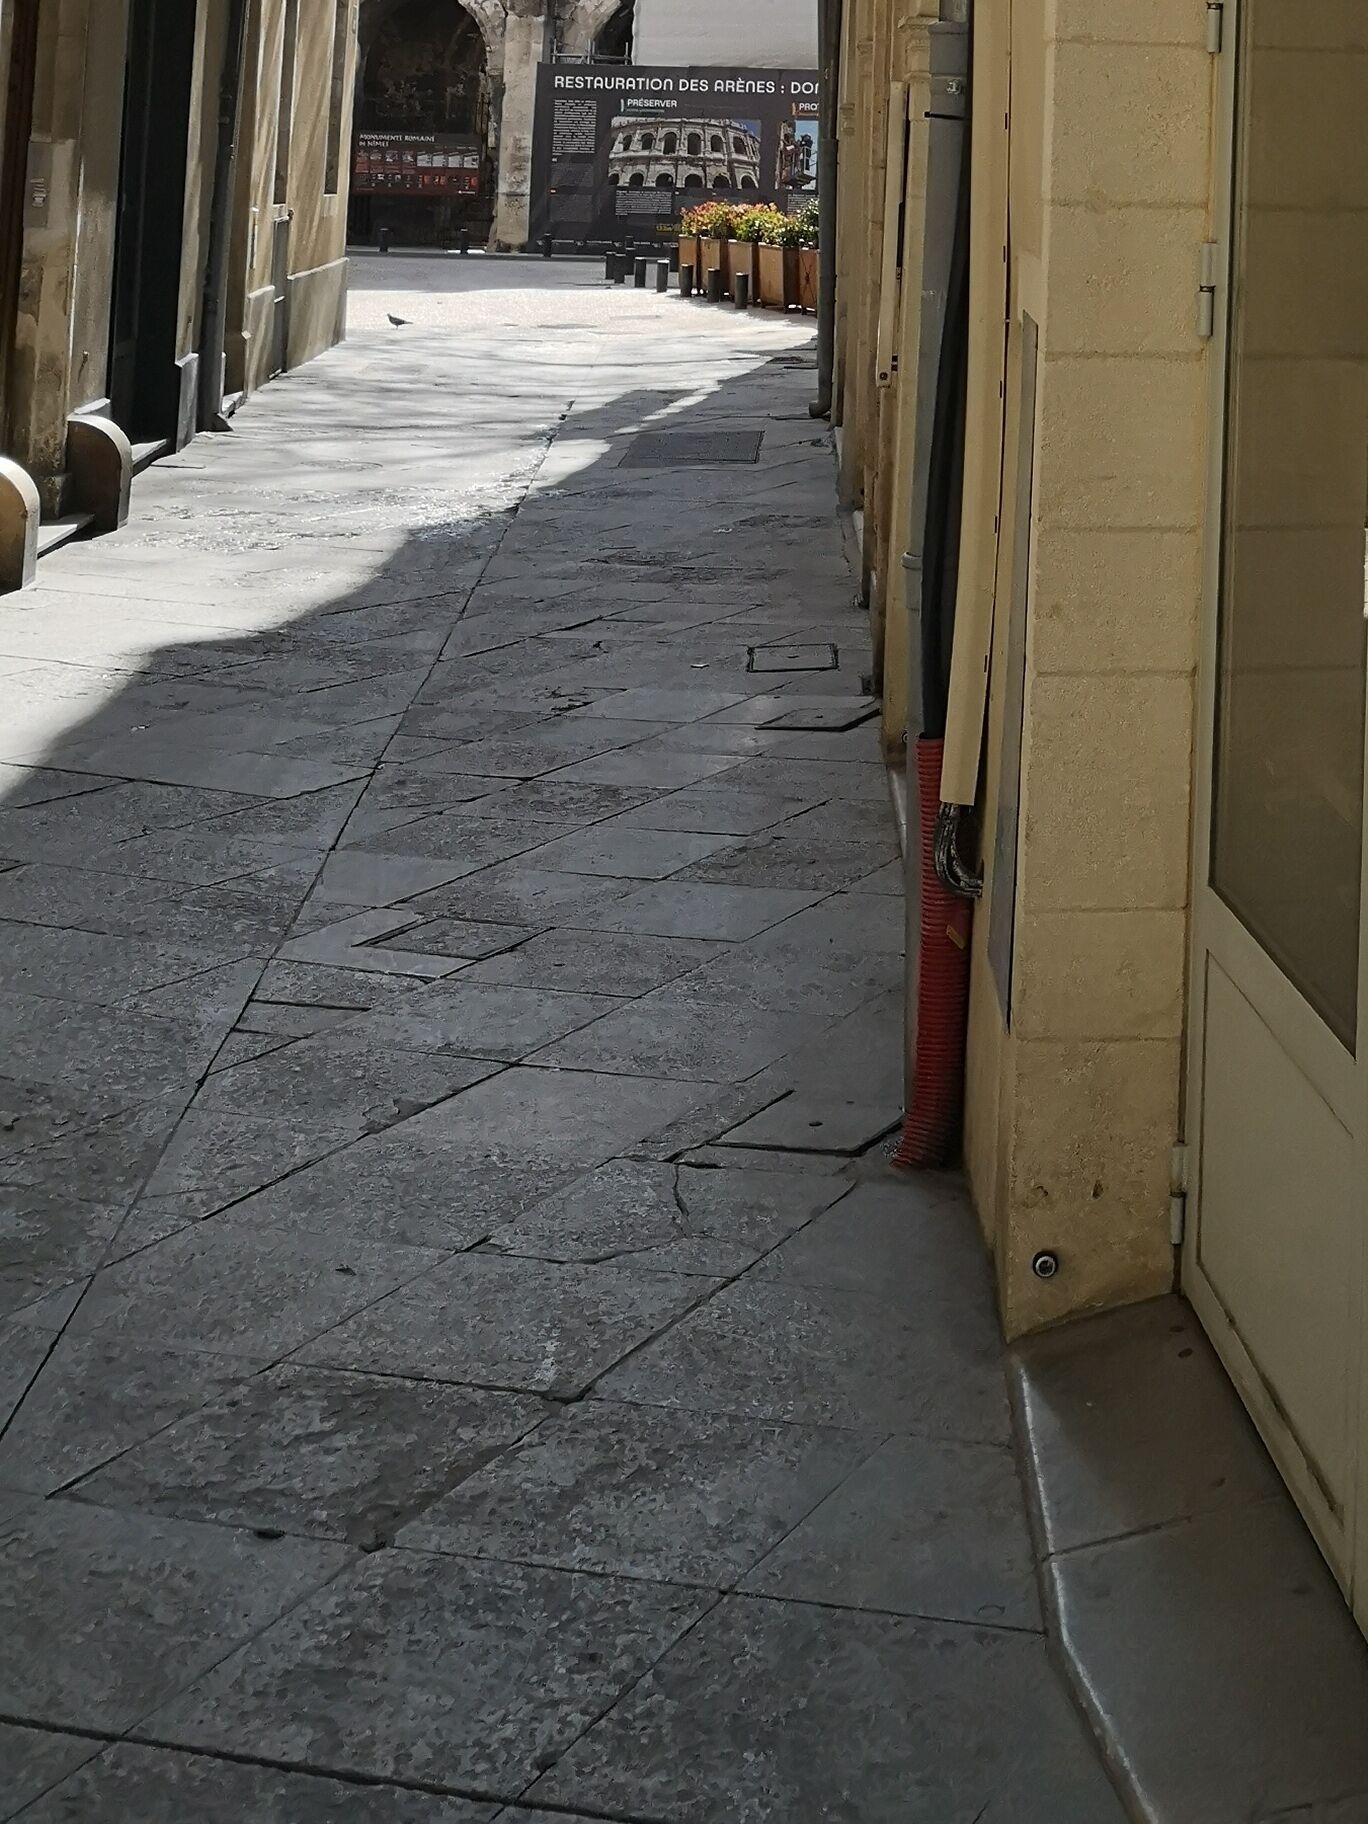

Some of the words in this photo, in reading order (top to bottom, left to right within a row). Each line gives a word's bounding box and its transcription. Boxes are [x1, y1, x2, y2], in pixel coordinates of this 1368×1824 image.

[554, 75, 674, 91] RESTAURATION
[678, 78, 709, 93] DES
[714, 77, 776, 95] ARÈNES
[626, 97, 678, 108] PRÉSERVER
[799, 102, 819, 112] PRO
